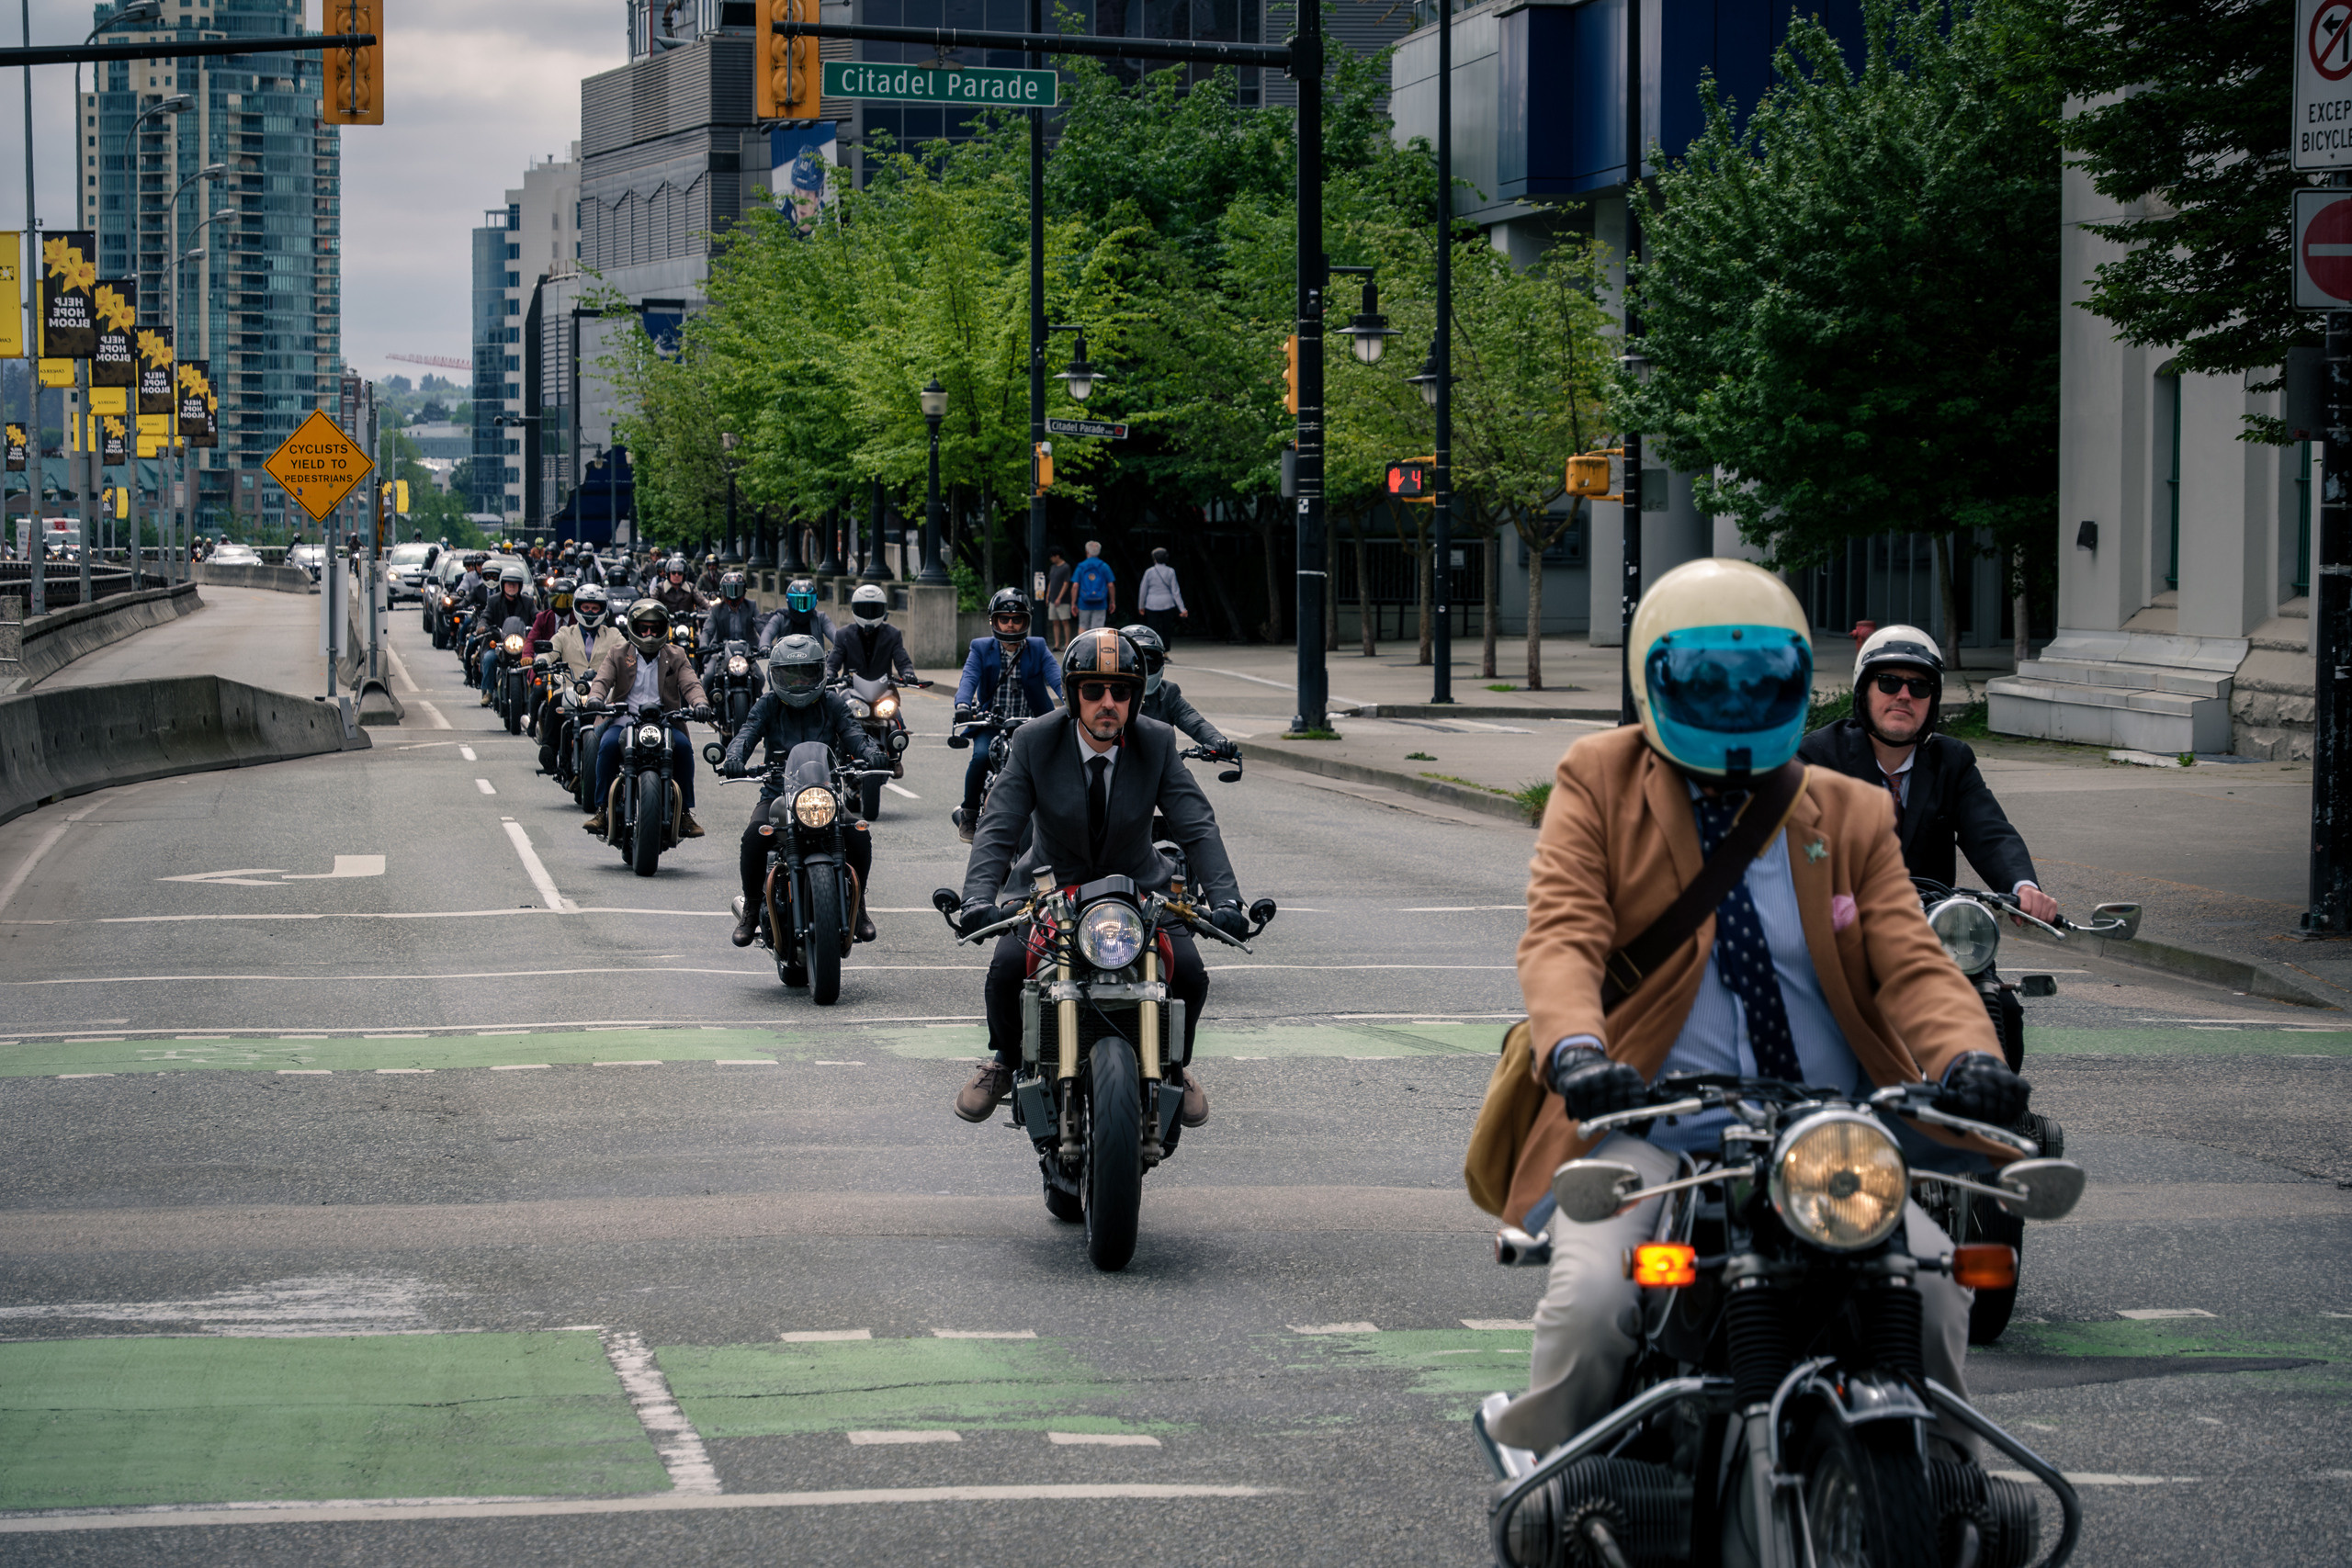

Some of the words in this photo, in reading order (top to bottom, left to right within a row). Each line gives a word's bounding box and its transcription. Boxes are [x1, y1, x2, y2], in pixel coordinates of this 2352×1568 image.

[842, 67, 934, 96] Citadel
[948, 73, 1038, 99] Parade
[1051, 421, 1078, 432] Citadel
[1080, 423, 1105, 434] Parade
[288, 444, 348, 454] CYCLISTS
[291, 459, 325, 468] YIELD
[331, 459, 347, 468] TO
[284, 474, 353, 482] PEDESTRIANS
[1411, 470, 1421, 490] 4
